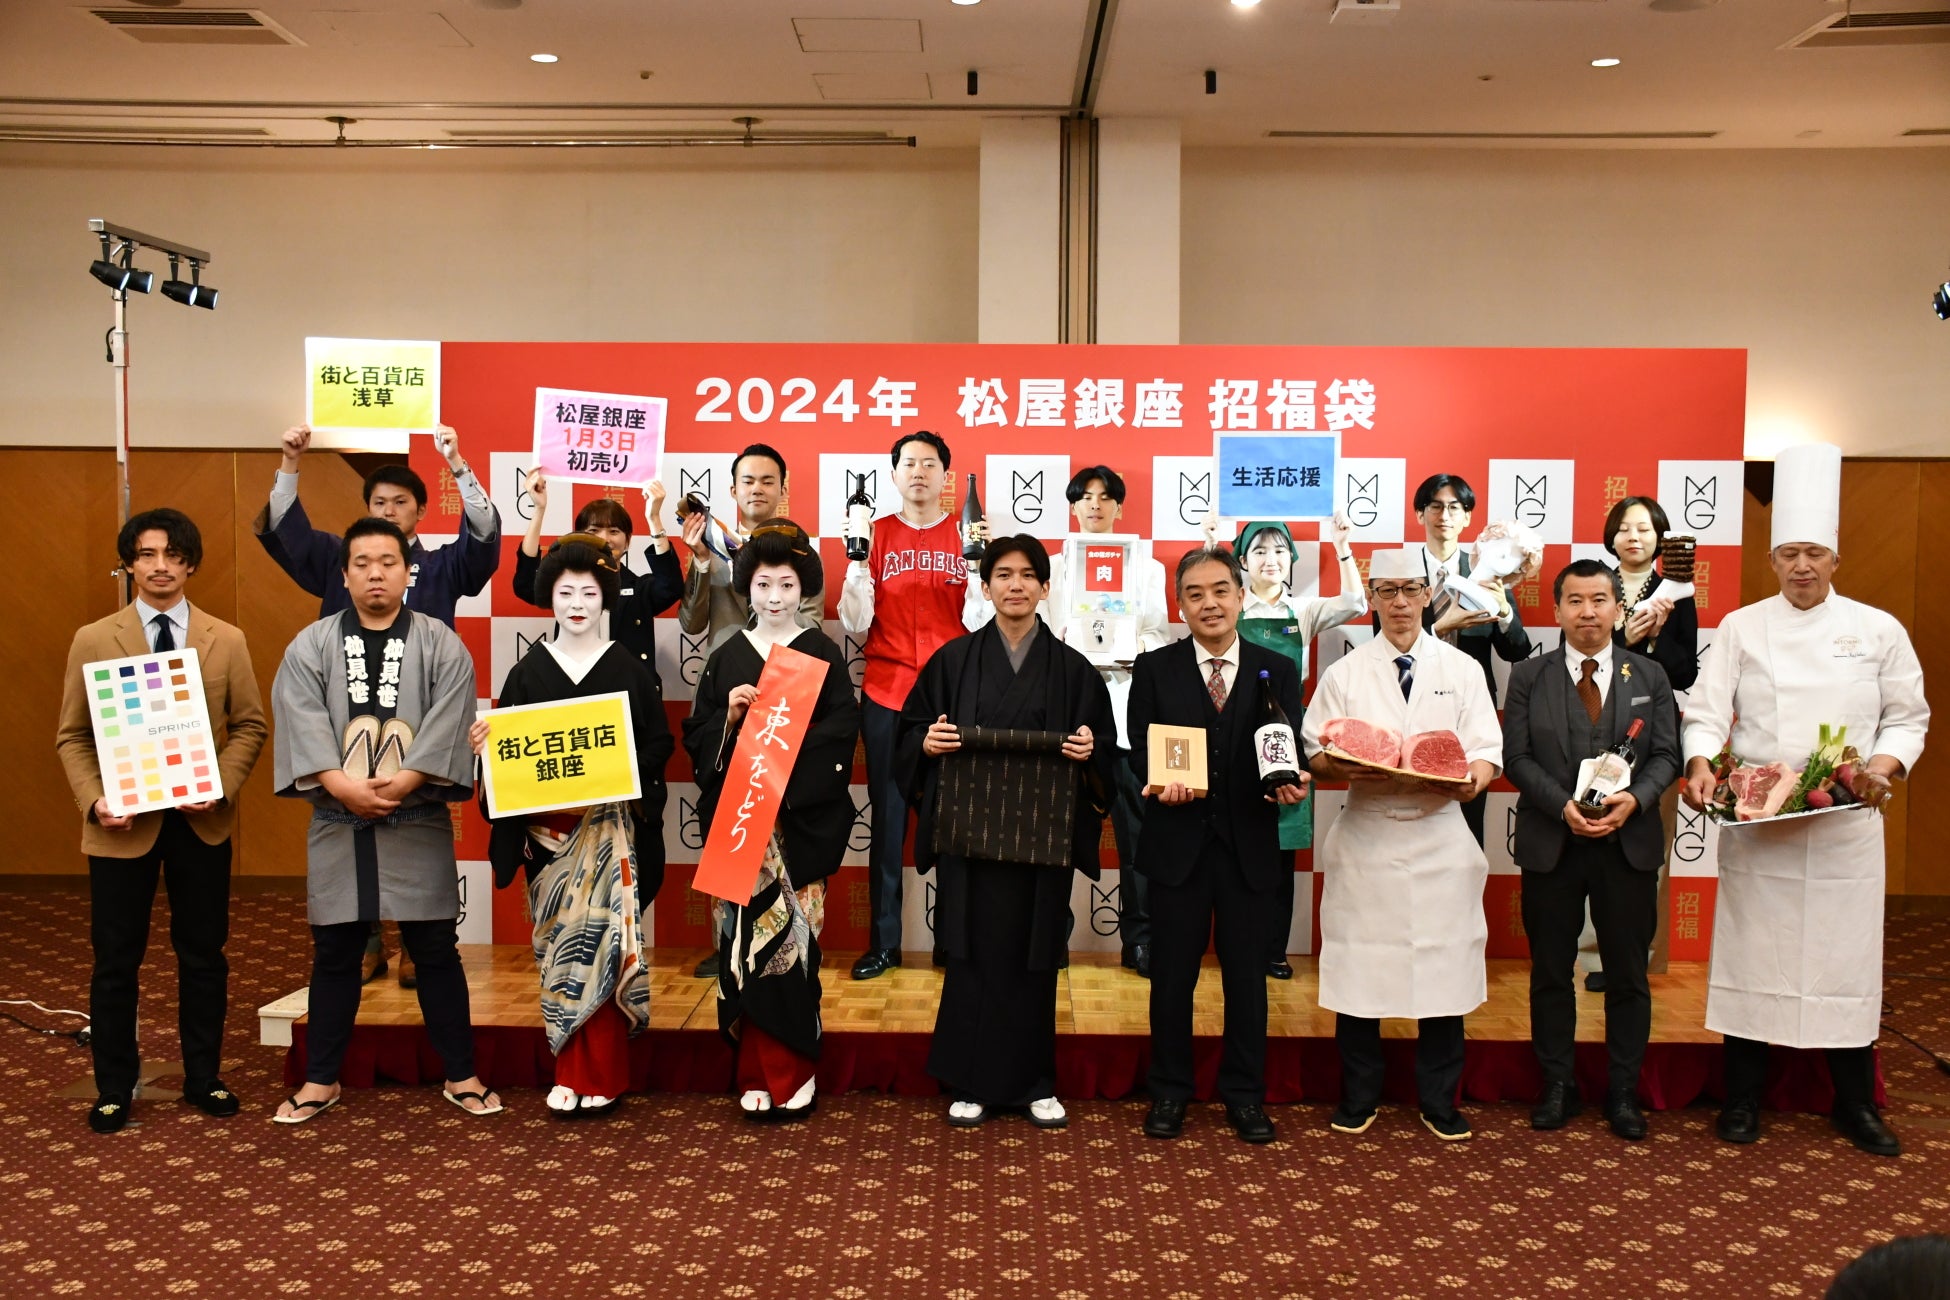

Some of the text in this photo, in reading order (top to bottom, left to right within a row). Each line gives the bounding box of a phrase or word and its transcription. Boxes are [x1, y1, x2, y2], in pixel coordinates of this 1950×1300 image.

[321, 365, 425, 386] 街と百貨店
[352, 388, 394, 407] 浅草
[695, 376, 1377, 431] 2024年 松屋銀座 招福袋
[556, 402, 646, 429] 松屋銀座
[567, 449, 628, 474] 初売り
[1232, 466, 1321, 487] 生活応援
[882, 549, 968, 581] ANGELS
[1096, 565, 1112, 582] 肉
[344, 634, 370, 704] 仲見世
[376, 638, 405, 708] 仲見世
[148, 720, 201, 736] SPRING
[497, 724, 616, 762] 街と百貨店
[535, 754, 586, 782] 銀座
[729, 696, 791, 853] 東をどり
[1675, 891, 1700, 941] 招福
